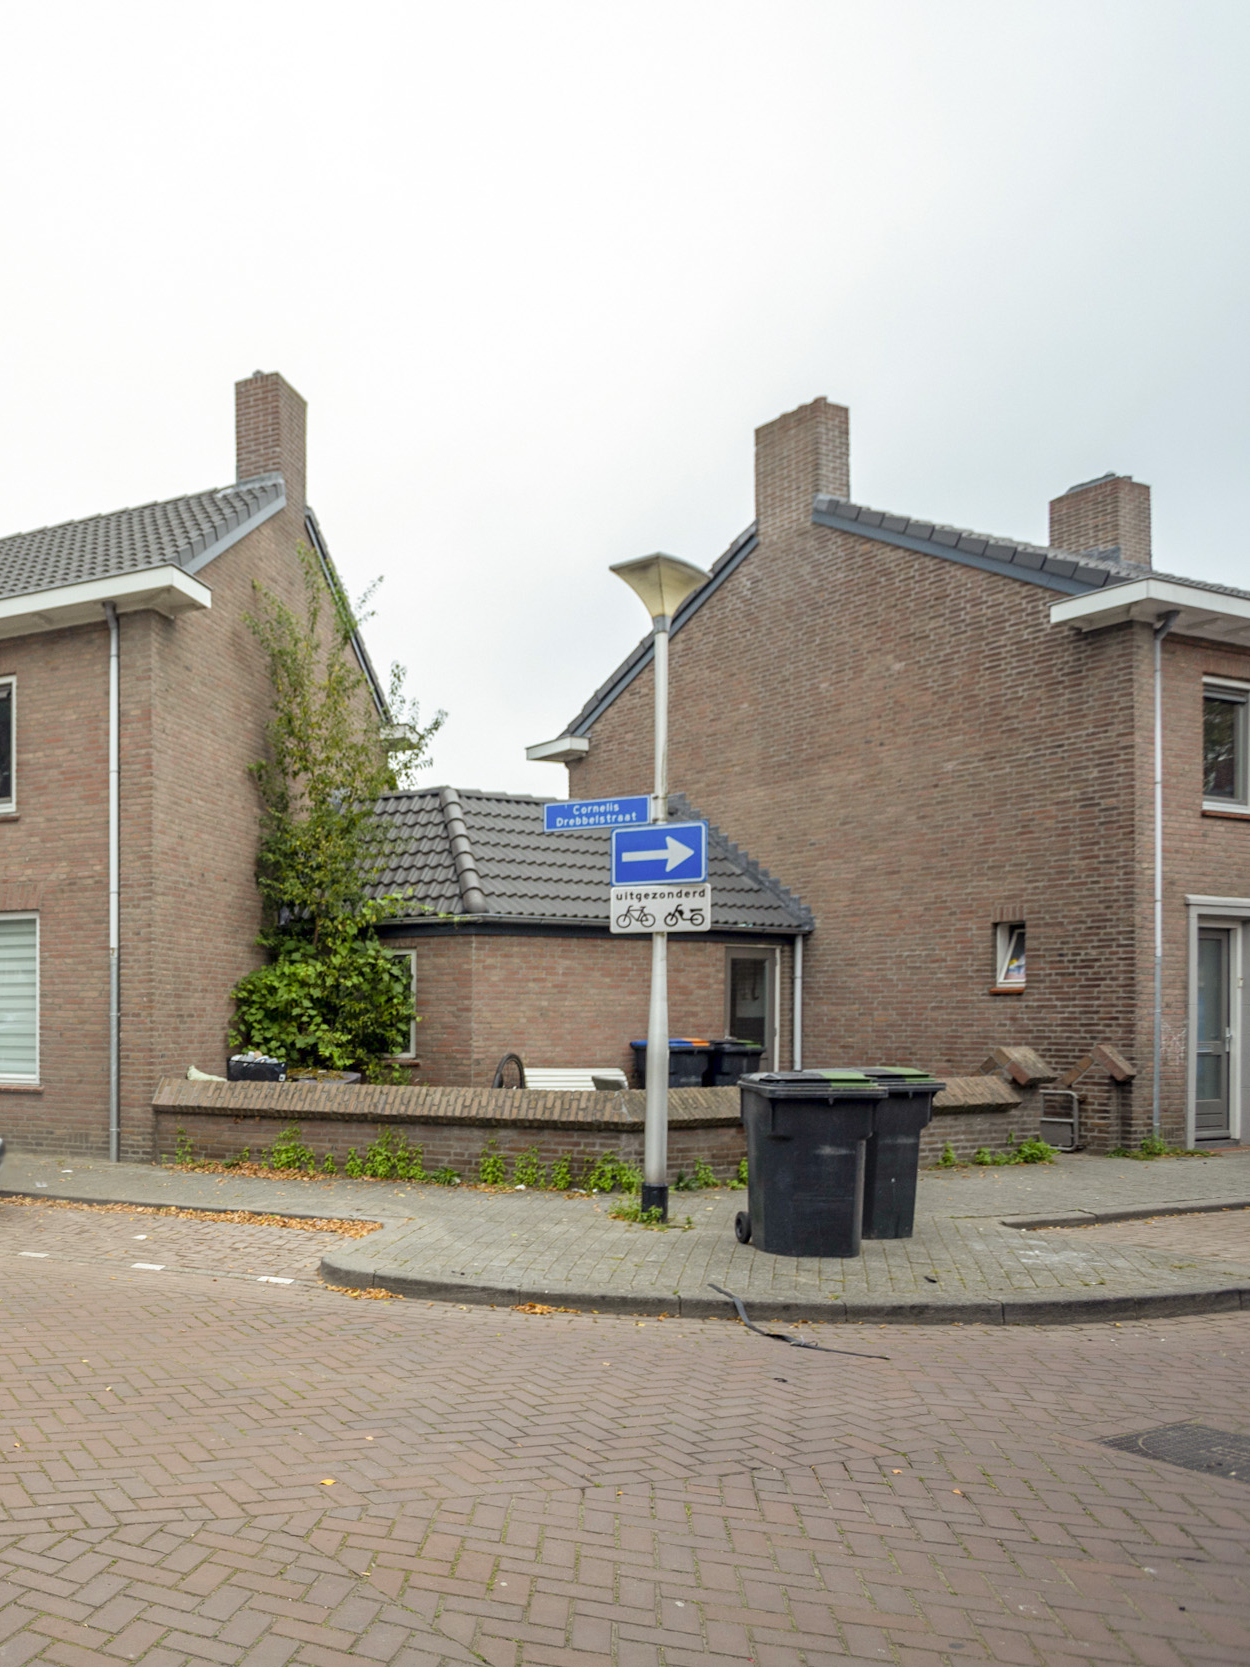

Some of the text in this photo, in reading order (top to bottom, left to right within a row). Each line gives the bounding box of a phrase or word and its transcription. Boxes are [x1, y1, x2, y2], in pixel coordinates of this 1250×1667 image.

[573, 802, 619, 815] Cornelis
[556, 812, 637, 827] Drebbelstraat
[616, 889, 706, 902] uitgezonderd
